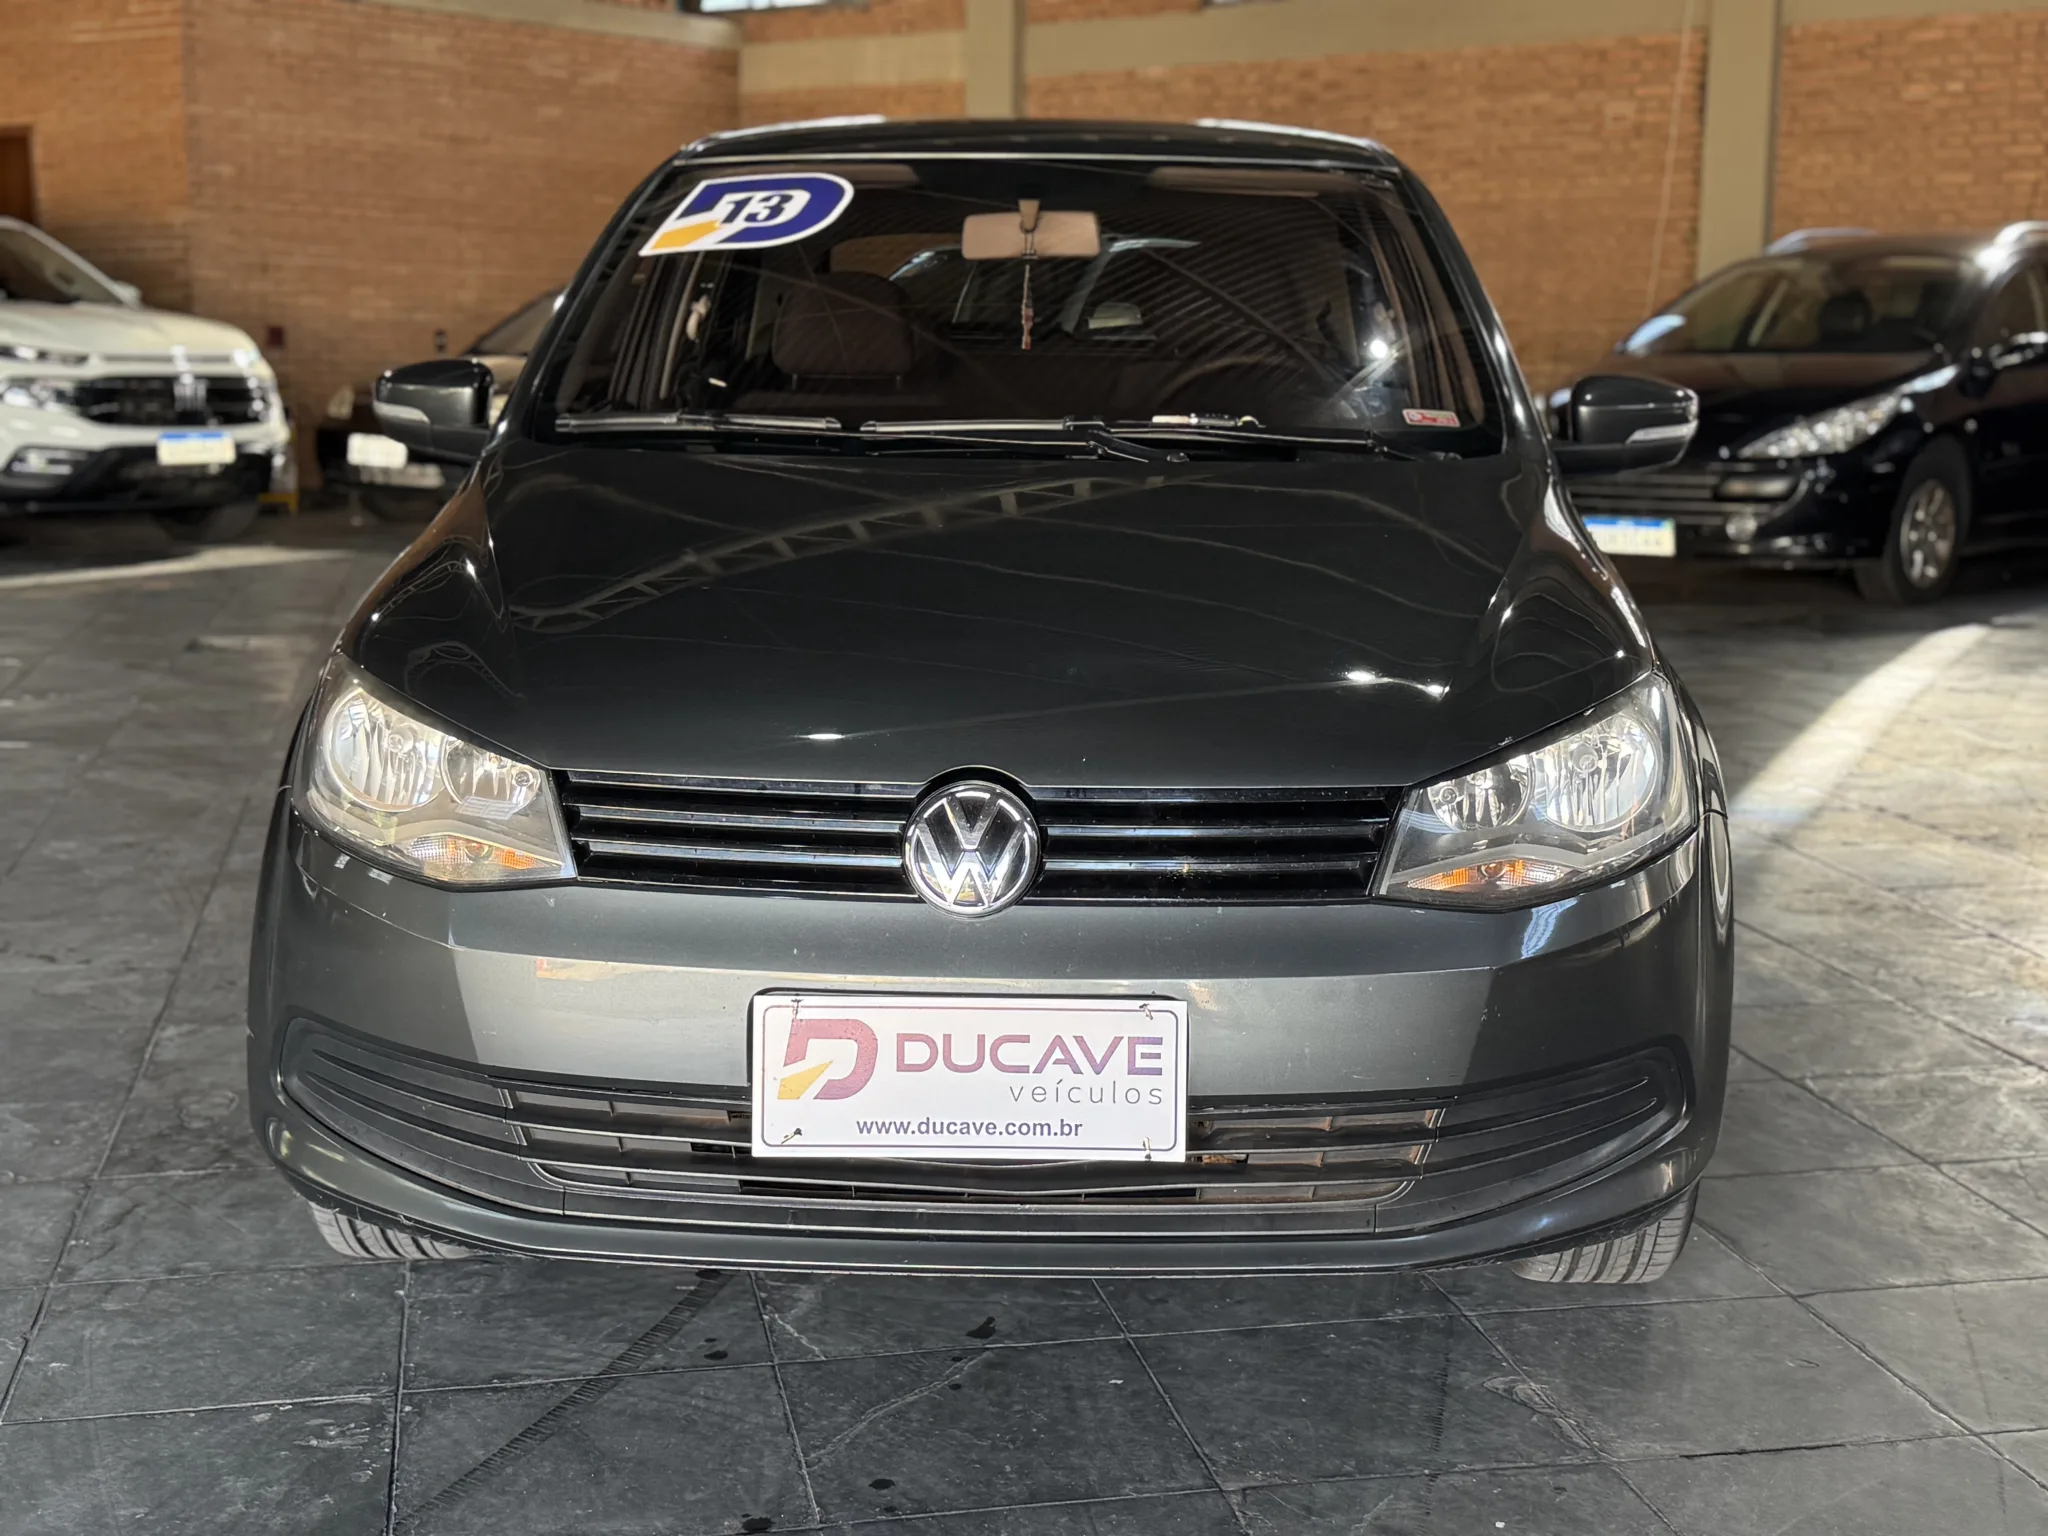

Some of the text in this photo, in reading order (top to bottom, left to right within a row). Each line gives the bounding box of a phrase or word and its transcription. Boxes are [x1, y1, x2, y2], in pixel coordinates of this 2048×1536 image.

[721, 194, 795, 224] 13
[896, 1032, 1164, 1076] DUCAVE
[1009, 1079, 1164, 1105] veículos
[856, 1116, 1084, 1138] www.ducave.com.br
